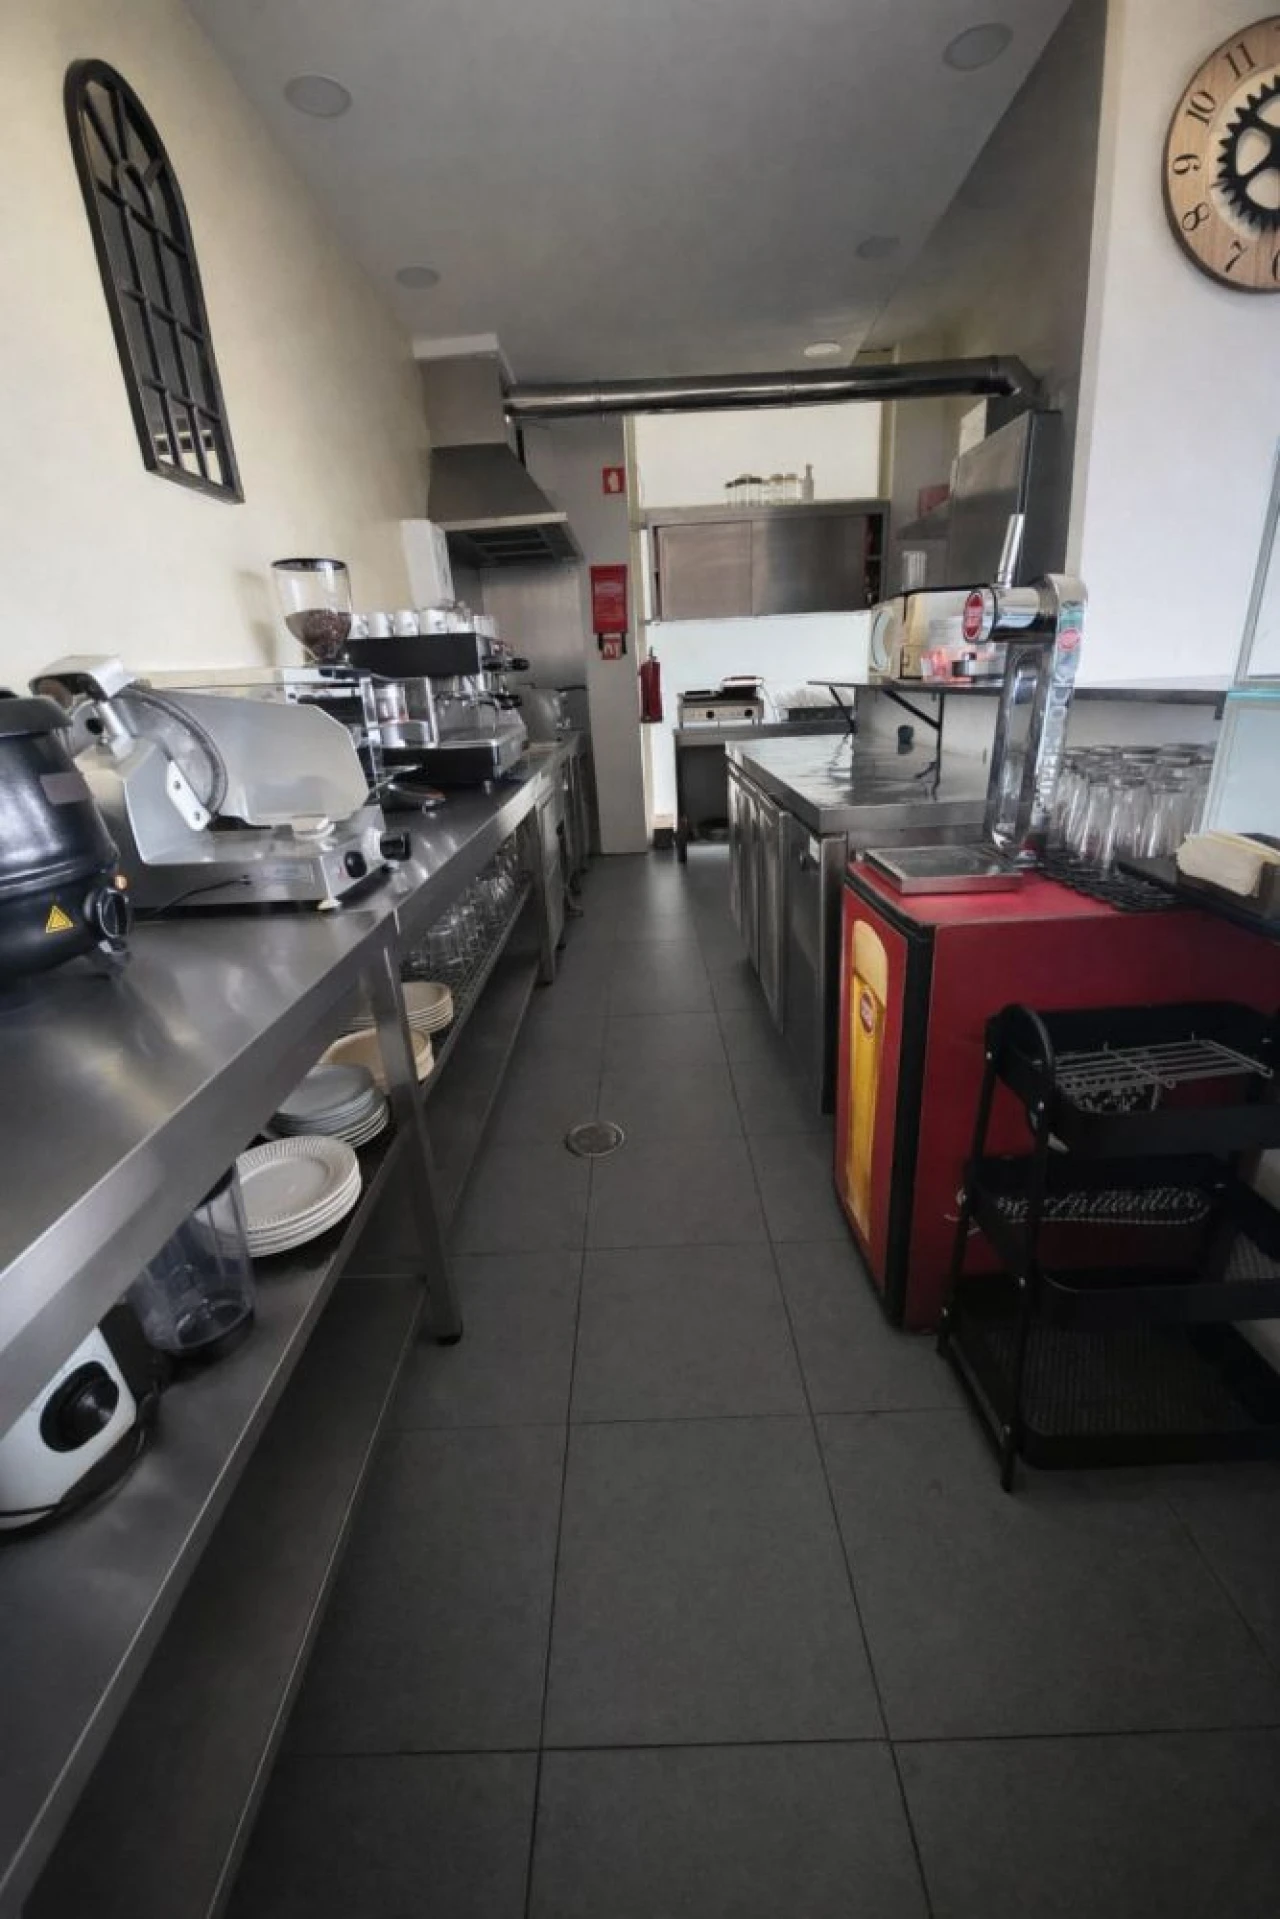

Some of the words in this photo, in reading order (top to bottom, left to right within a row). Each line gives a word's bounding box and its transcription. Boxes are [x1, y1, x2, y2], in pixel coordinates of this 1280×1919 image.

[1224, 42, 1255, 79] 11
[1186, 91, 1215, 126] 10
[1172, 153, 1202, 176] 9
[1181, 202, 1210, 231] 8
[1224, 240, 1249, 273] 7
